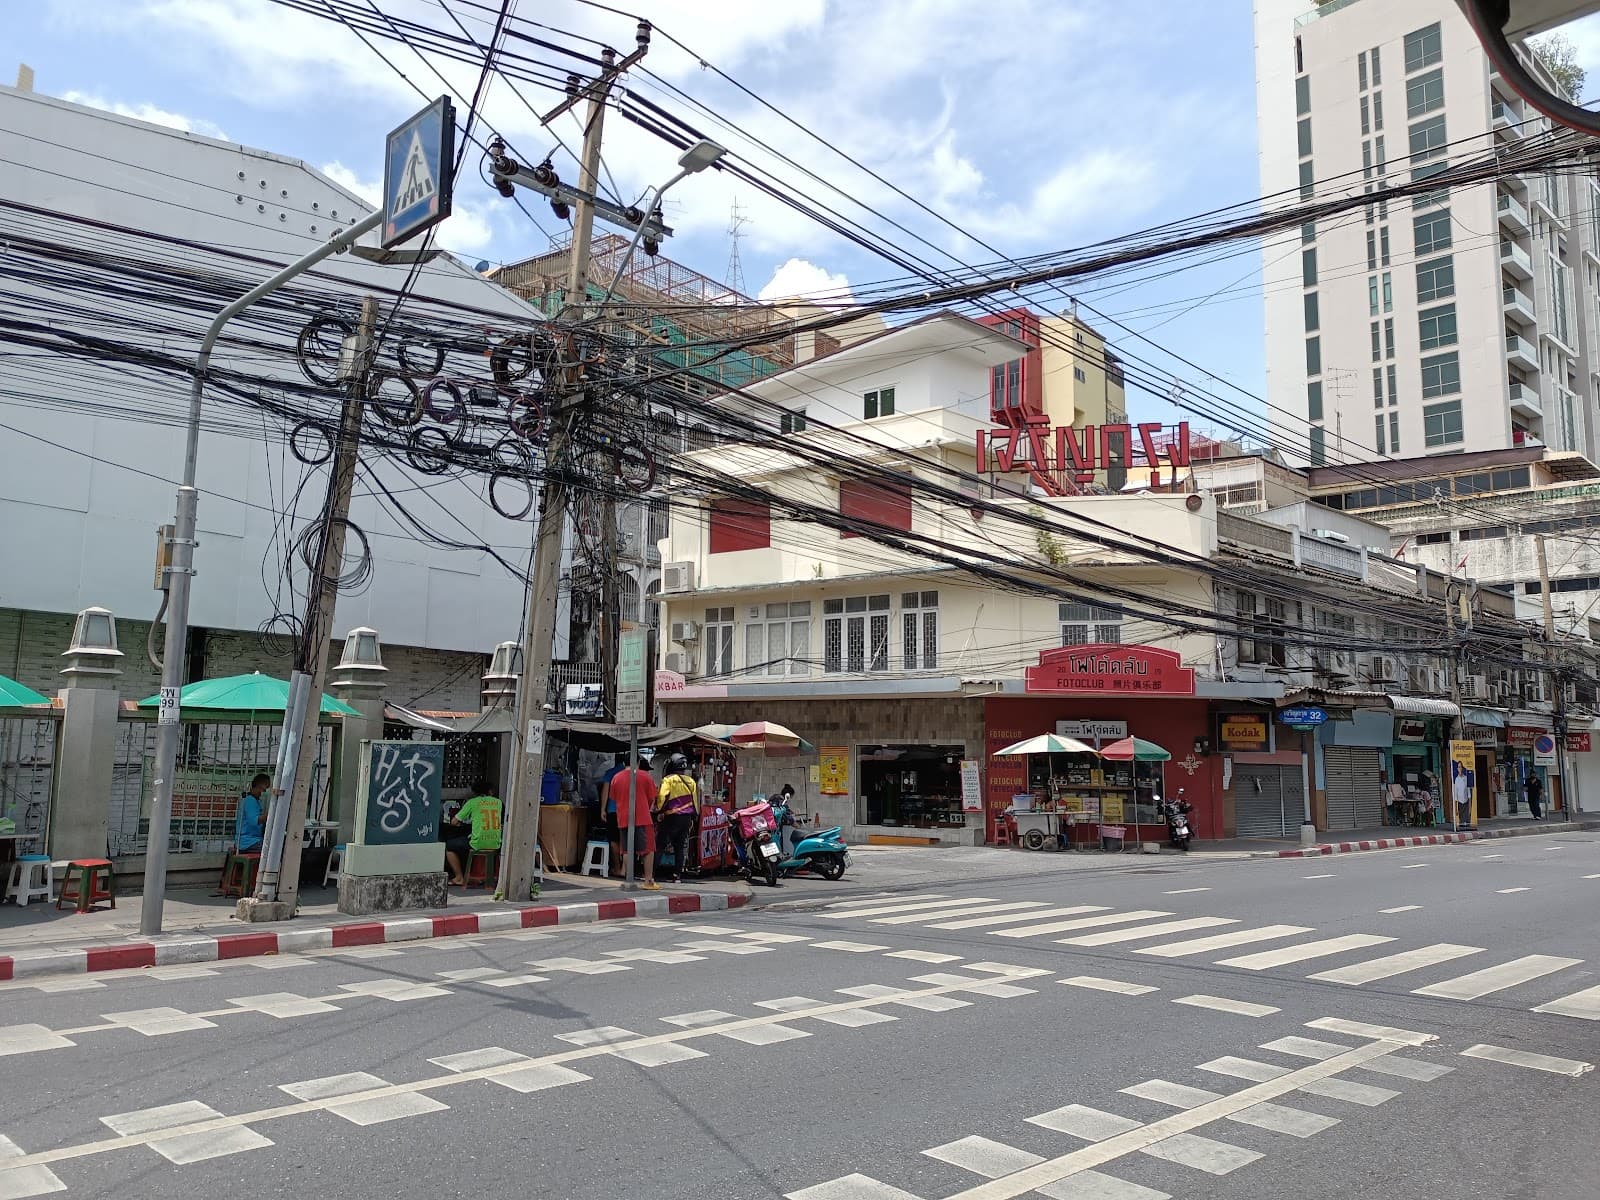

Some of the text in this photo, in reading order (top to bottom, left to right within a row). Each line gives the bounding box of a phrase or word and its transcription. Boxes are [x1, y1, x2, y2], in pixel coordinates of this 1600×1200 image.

[656, 682, 684, 691] KBAR
[1057, 678, 1105, 689] FOTOCLUB
[1310, 711, 1322, 720] 32
[989, 730, 1022, 738] FOTOCLUB
[1227, 727, 1260, 737] Kodak
[990, 777, 1023, 785] FOTOCLUB
[990, 801, 1013, 809] FOTOC
